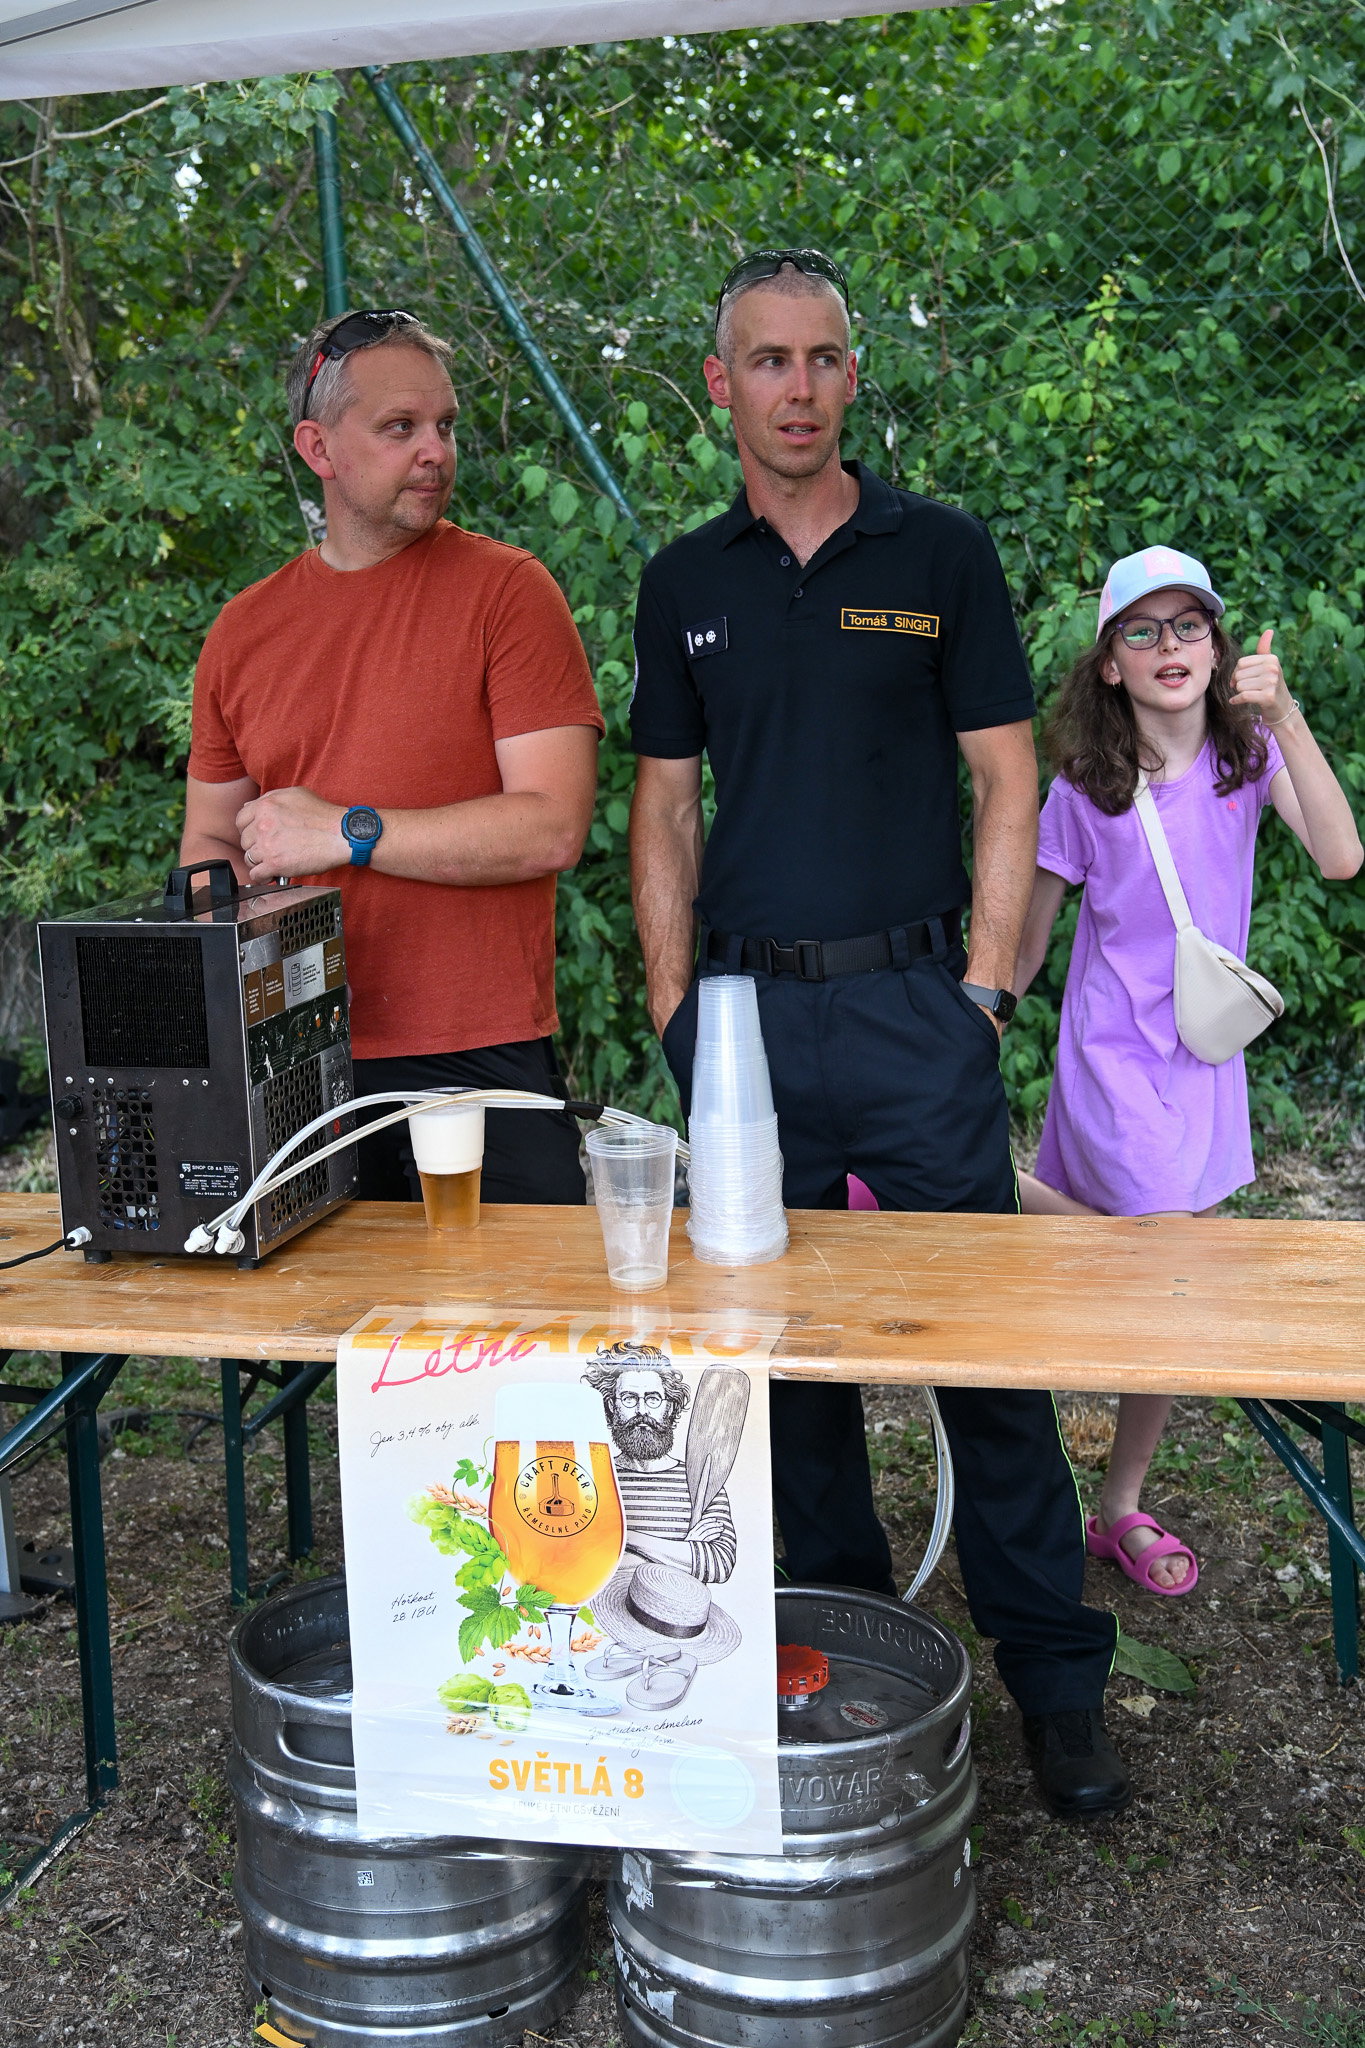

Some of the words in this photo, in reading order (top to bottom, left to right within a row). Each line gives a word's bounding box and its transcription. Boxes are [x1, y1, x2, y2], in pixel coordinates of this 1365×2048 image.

[848, 614, 888, 627] Tomáš
[894, 616, 931, 632] SINGR
[352, 1314, 763, 1357] LEHÁRKO
[370, 1331, 539, 1394] Letní
[369, 1430, 395, 1458] Jen
[459, 1413, 480, 1429] alk.
[519, 1460, 554, 1489] CRAFT
[562, 1462, 591, 1489] BEER
[522, 1506, 570, 1534] ŘEMESLNÉ
[574, 1508, 592, 1528] PIVO
[392, 1611, 407, 1623] 28
[411, 1604, 438, 1620] IBU
[653, 1713, 704, 1732] chmeleno
[488, 1751, 614, 1798] SVĚTLÁ
[623, 1767, 645, 1799] 8
[779, 1767, 882, 1804] IVOVAR
